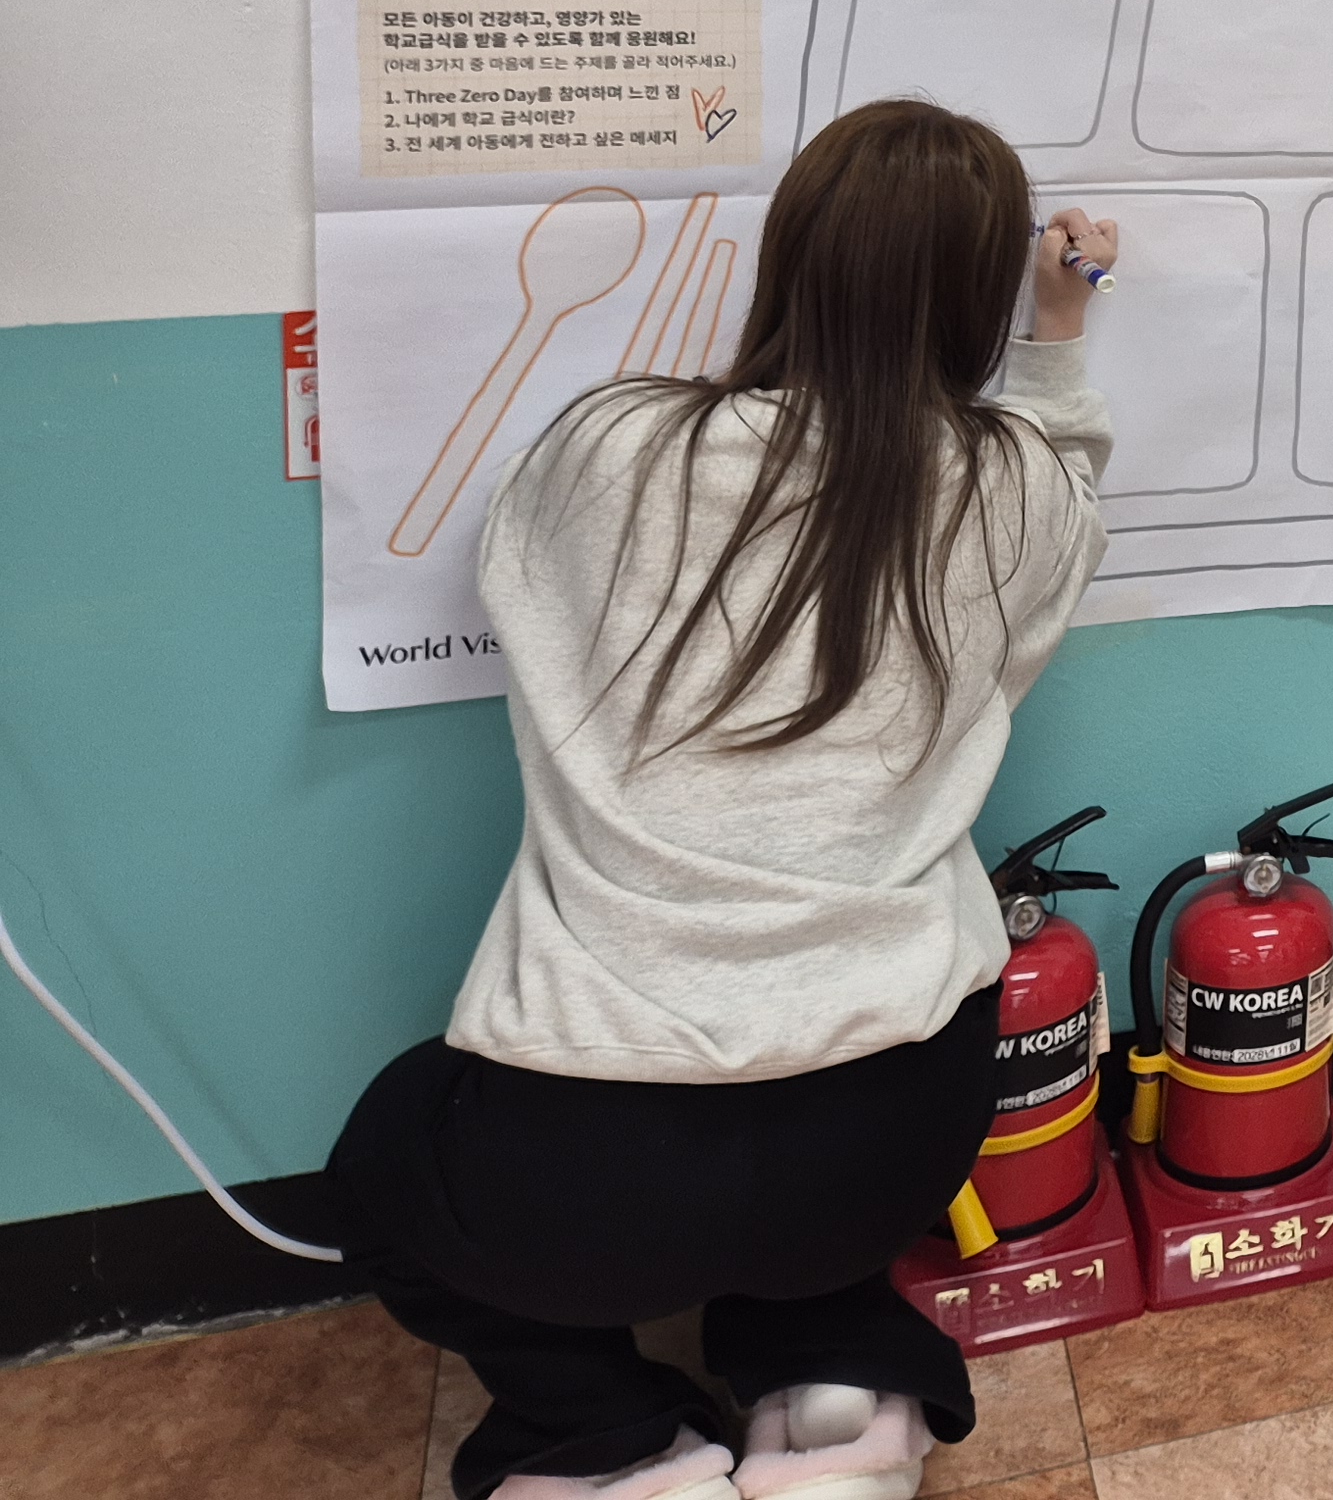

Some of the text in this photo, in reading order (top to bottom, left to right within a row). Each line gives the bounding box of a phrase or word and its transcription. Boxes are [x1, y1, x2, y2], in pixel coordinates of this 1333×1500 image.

[383, 10, 642, 28] 모든 아동이 건강하고, 영양가 있는
[383, 30, 696, 49] 학교급식을 받을 수 있도록 함께 응원해요!
[384, 55, 736, 74] (아래 3가지 중 마음에 드는 주제를 골라 적어주세요.)
[385, 85, 680, 105] 1. Three Zero Day를 참여하며 느낀 점
[384, 110, 575, 128] 2. 나에게 학교 급식이란?
[385, 130, 677, 152] 3. 전 세계 아동에게 전하고 싶은 메세지
[359, 632, 502, 667] World Vis
[1191, 984, 1304, 1012] CW KOREA
[1020, 1011, 1087, 1056] KOREA
